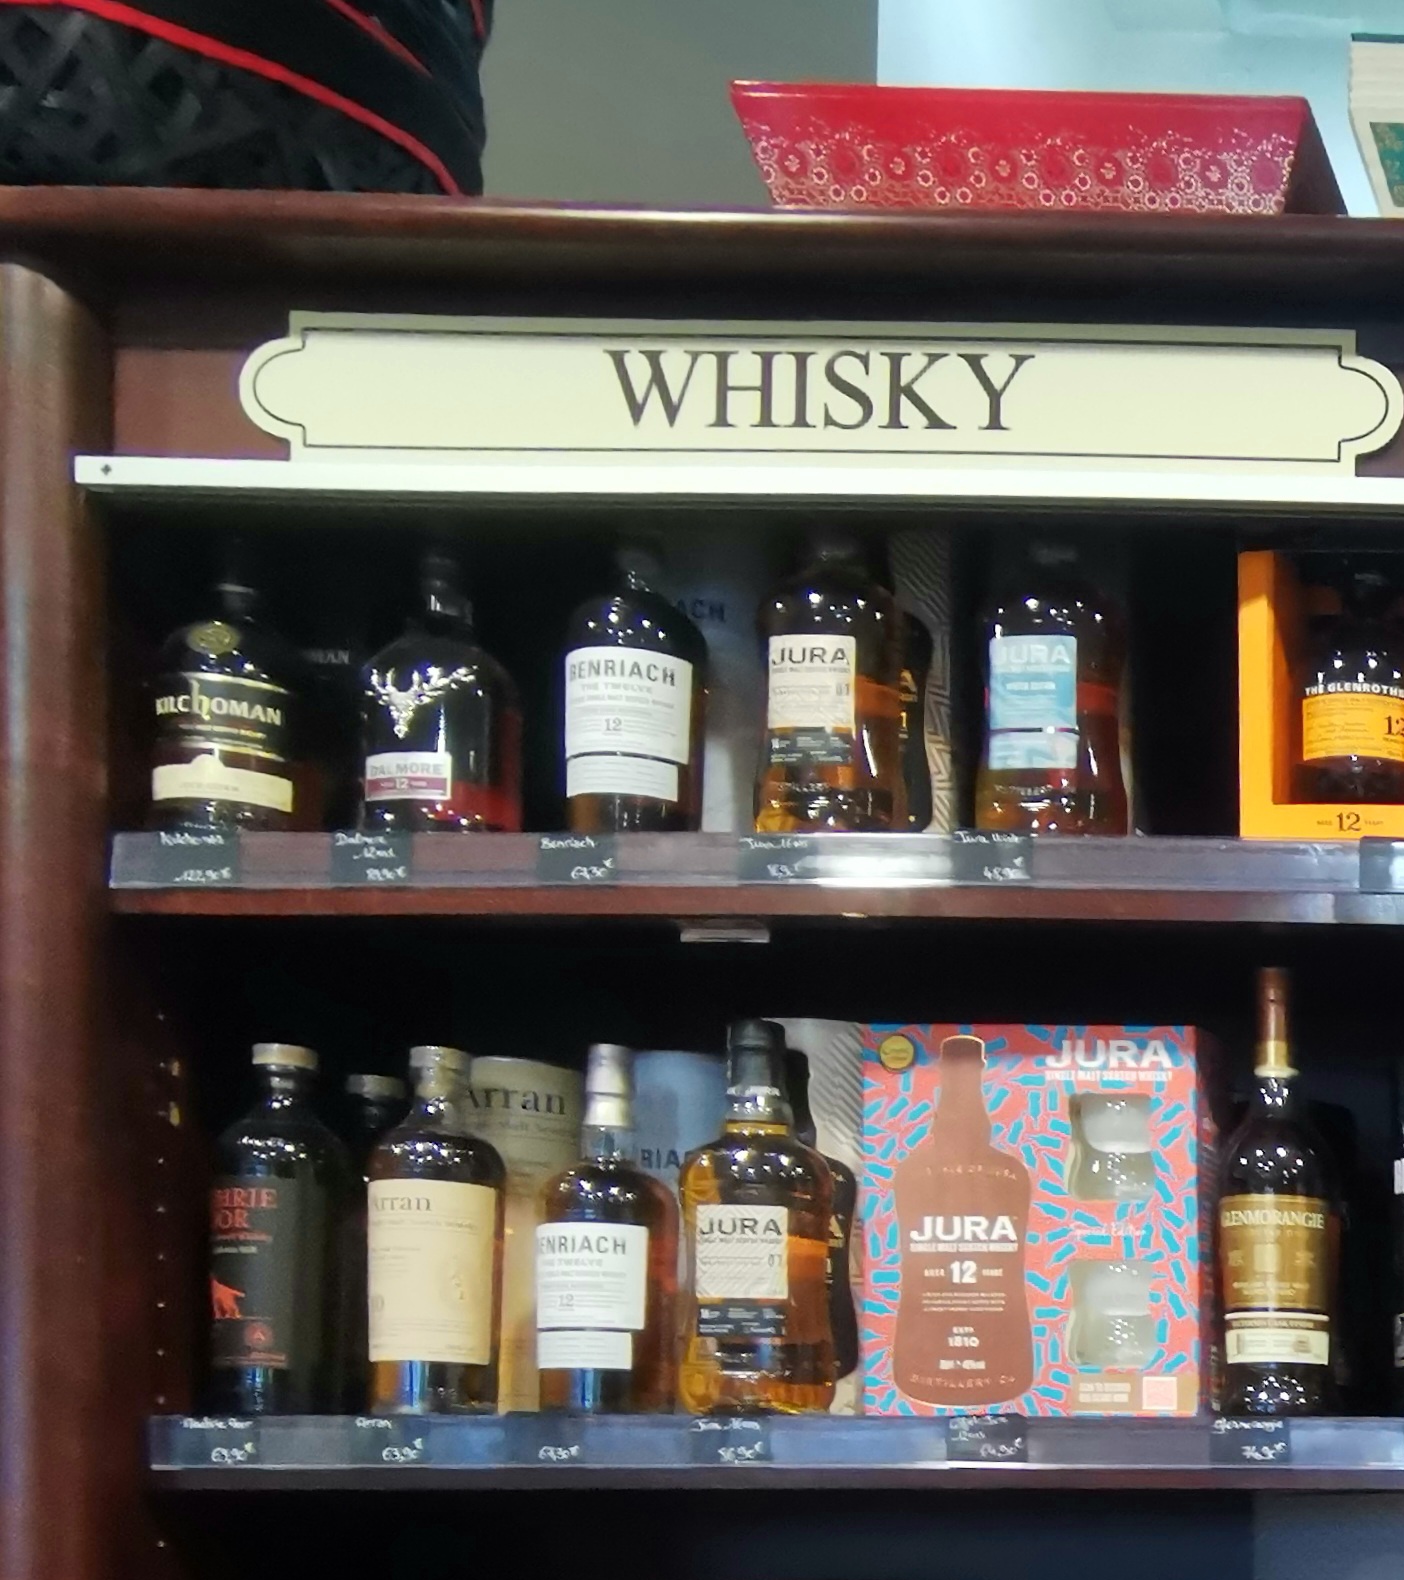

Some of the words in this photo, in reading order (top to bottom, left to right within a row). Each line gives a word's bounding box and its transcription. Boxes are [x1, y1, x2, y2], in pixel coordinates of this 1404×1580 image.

[602, 347, 1037, 433] WHISKY
[771, 647, 850, 665] JURA
[996, 643, 1071, 665] JURA
[569, 659, 676, 687] BENRIACH
[1304, 685, 1324, 696] THE
[604, 718, 622, 731] 12
[369, 762, 444, 776] DALMORE
[395, 778, 409, 789] 12
[1336, 812, 1362, 832] 12
[1045, 1039, 1173, 1069] JURA
[699, 1217, 783, 1237] JURA
[910, 1215, 1017, 1242] JURA
[1222, 1210, 1325, 1229] GLENMORANGIE
[950, 1261, 977, 1284] 12
